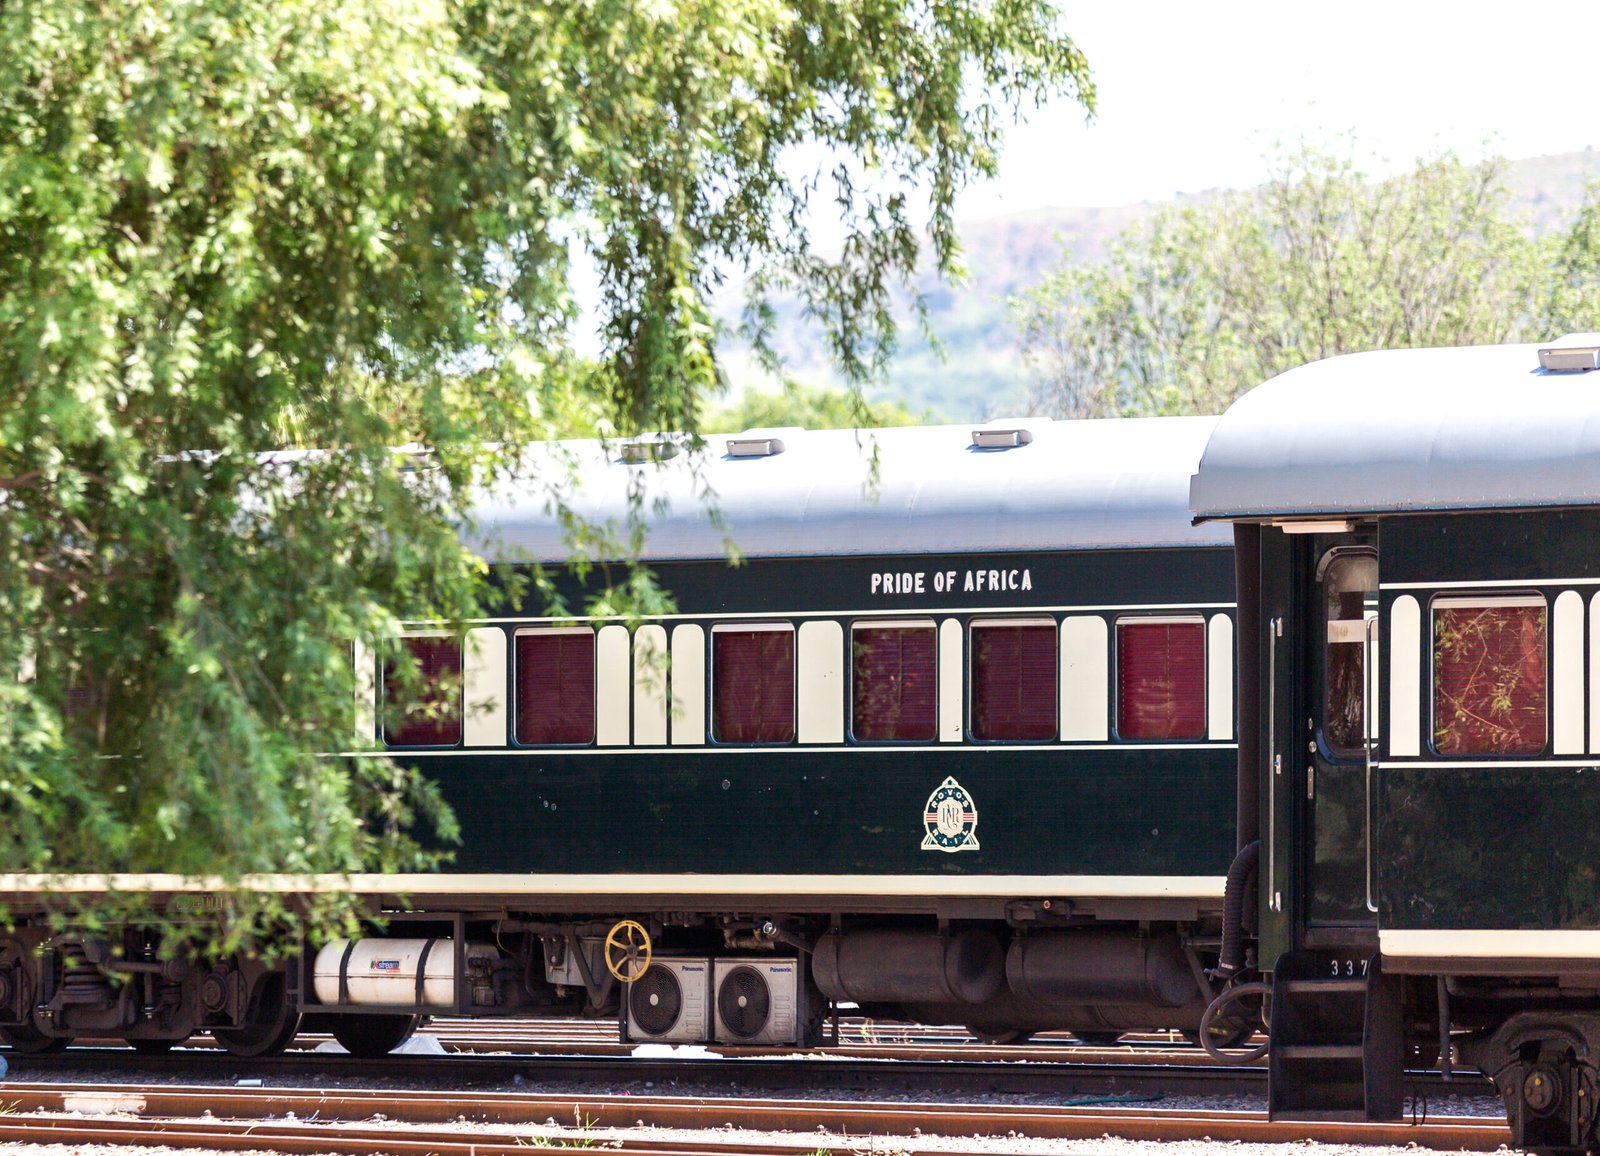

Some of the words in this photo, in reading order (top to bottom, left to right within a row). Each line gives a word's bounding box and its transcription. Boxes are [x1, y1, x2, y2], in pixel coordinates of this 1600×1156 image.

[871, 572, 925, 594] PRIDE
[933, 571, 957, 592] OF
[963, 568, 1032, 591] AFRICA
[931, 789, 969, 809] ROVOS
[932, 828, 969, 845] RAIL
[1331, 959, 1368, 976] 337
